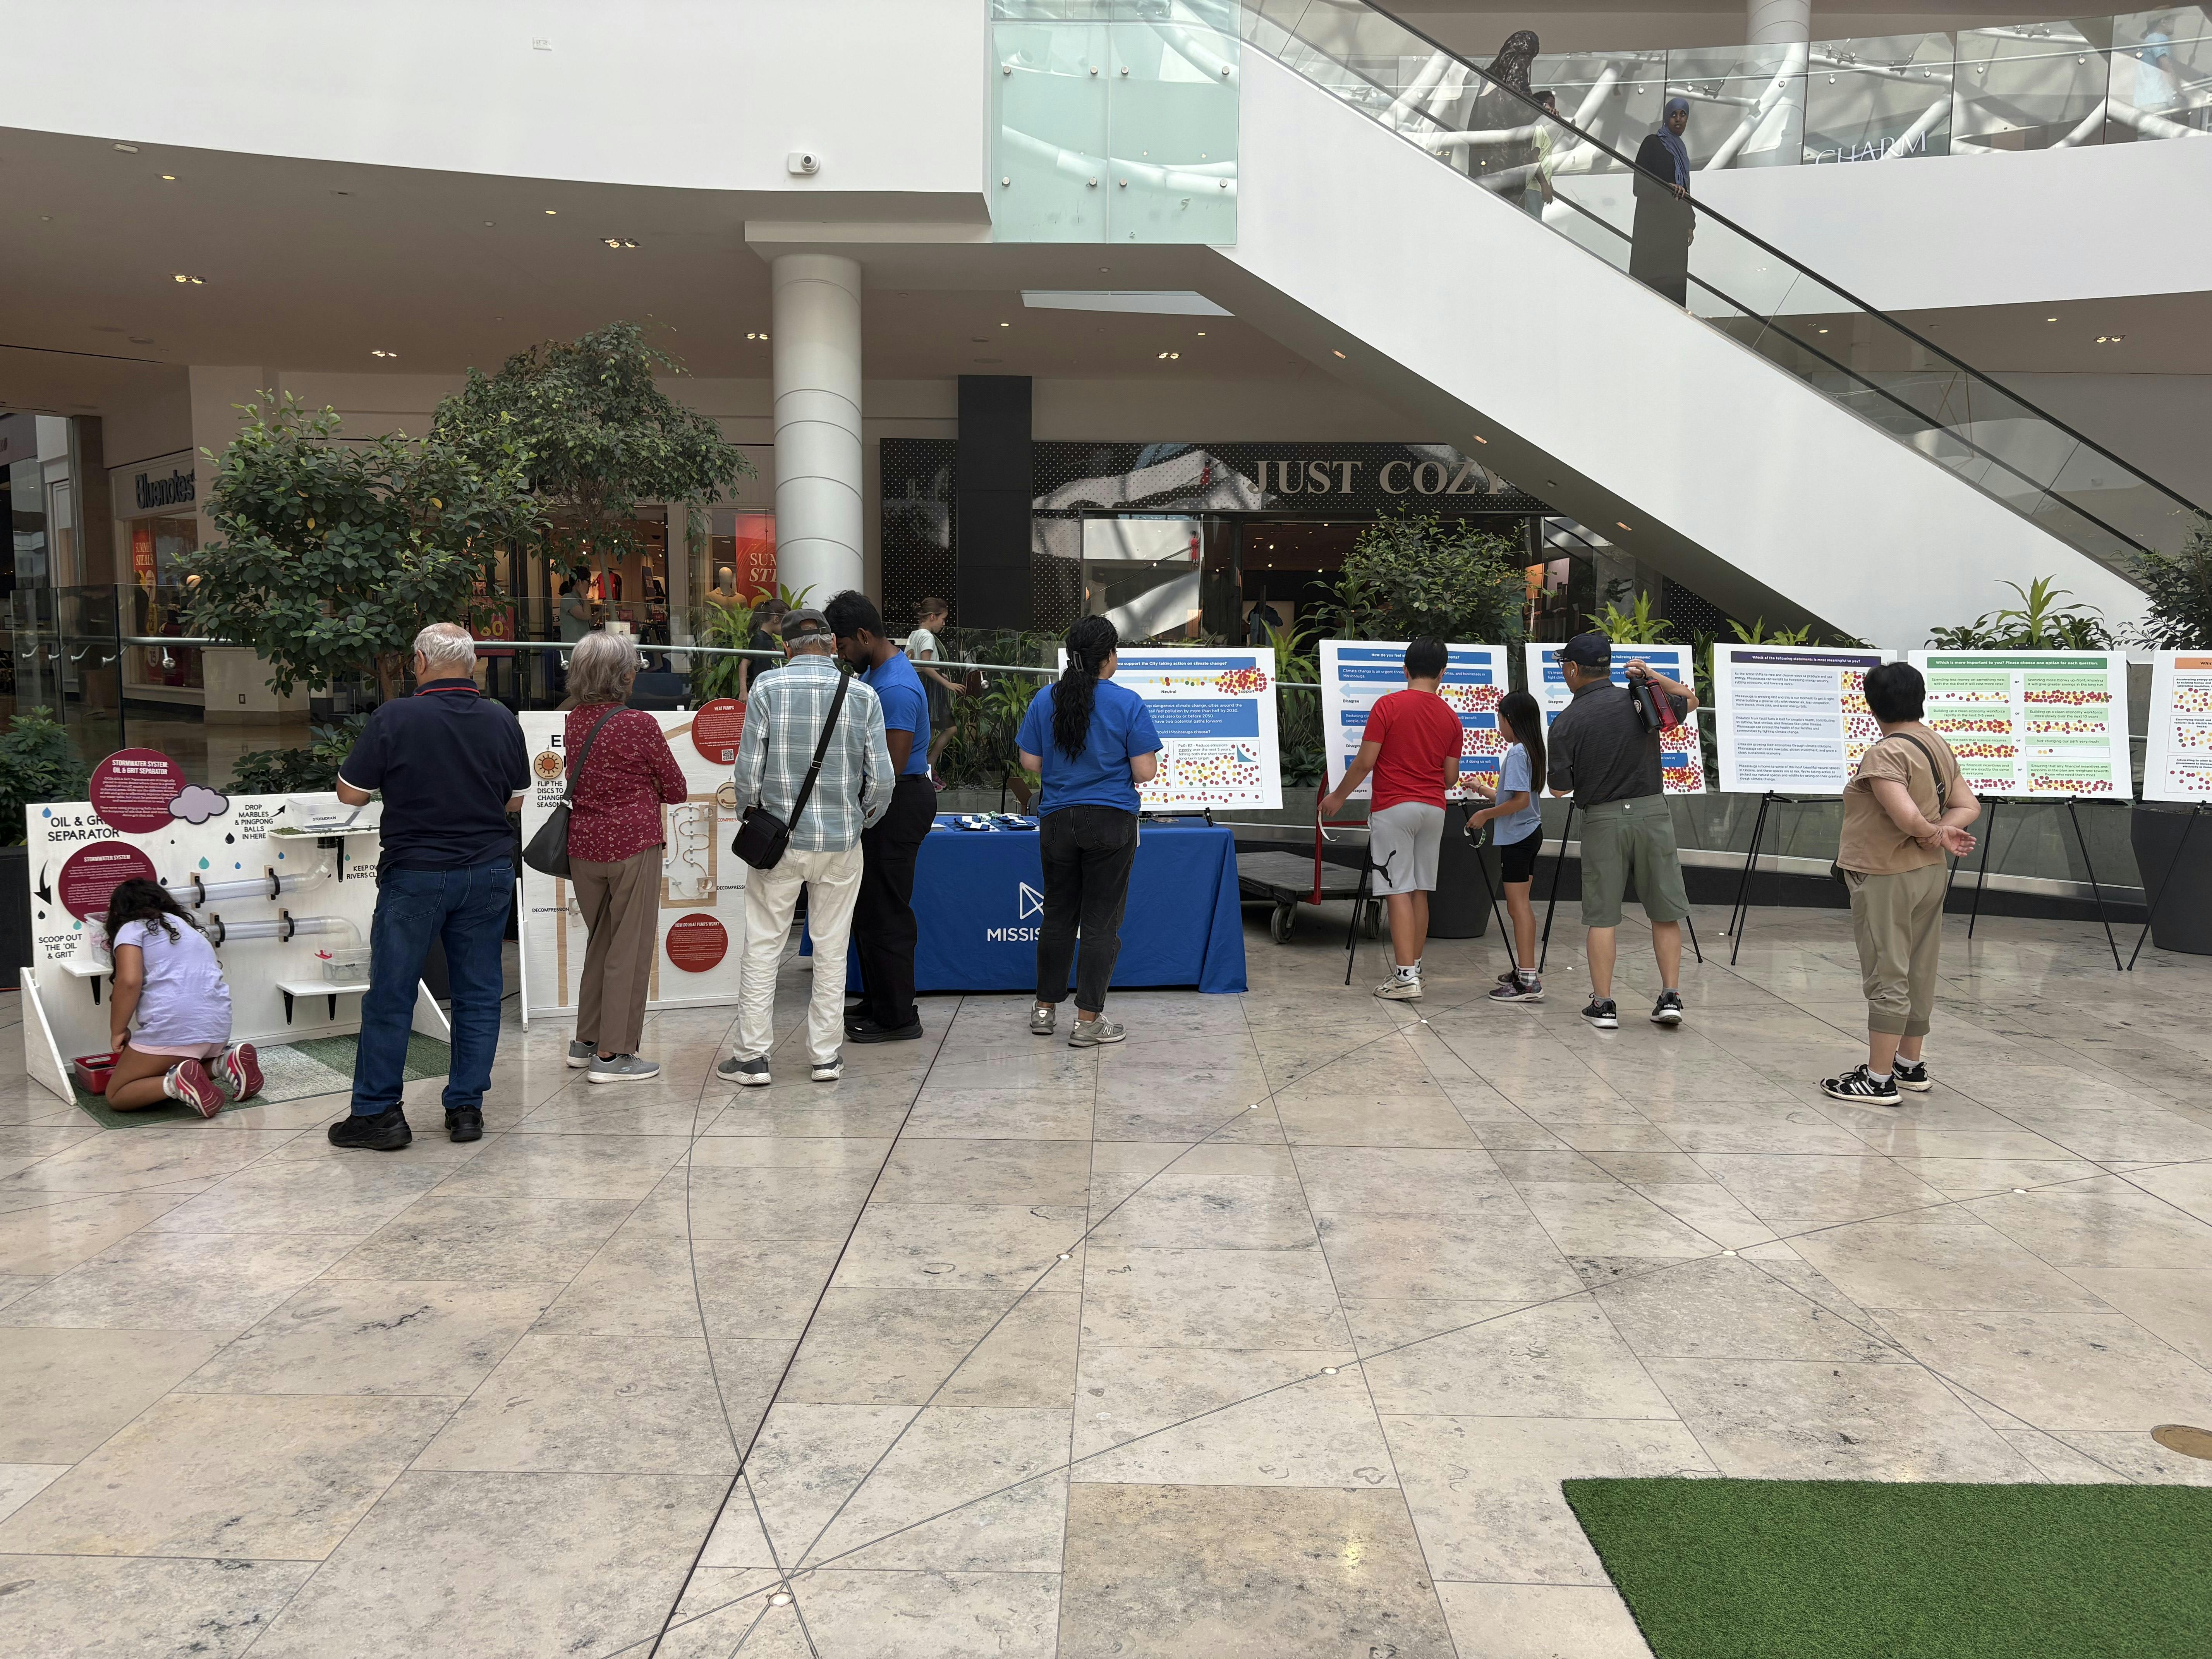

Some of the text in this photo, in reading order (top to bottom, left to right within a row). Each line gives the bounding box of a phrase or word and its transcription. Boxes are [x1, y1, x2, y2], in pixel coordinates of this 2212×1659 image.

[1815, 130, 1928, 164] CHARM
[1247, 460, 1362, 494] JUST
[135, 470, 194, 509] Bluenotes
[51, 815, 105, 827] OIL & GR
[48, 828, 120, 842] SEPARATOR
[38, 935, 64, 943] SCOOP
